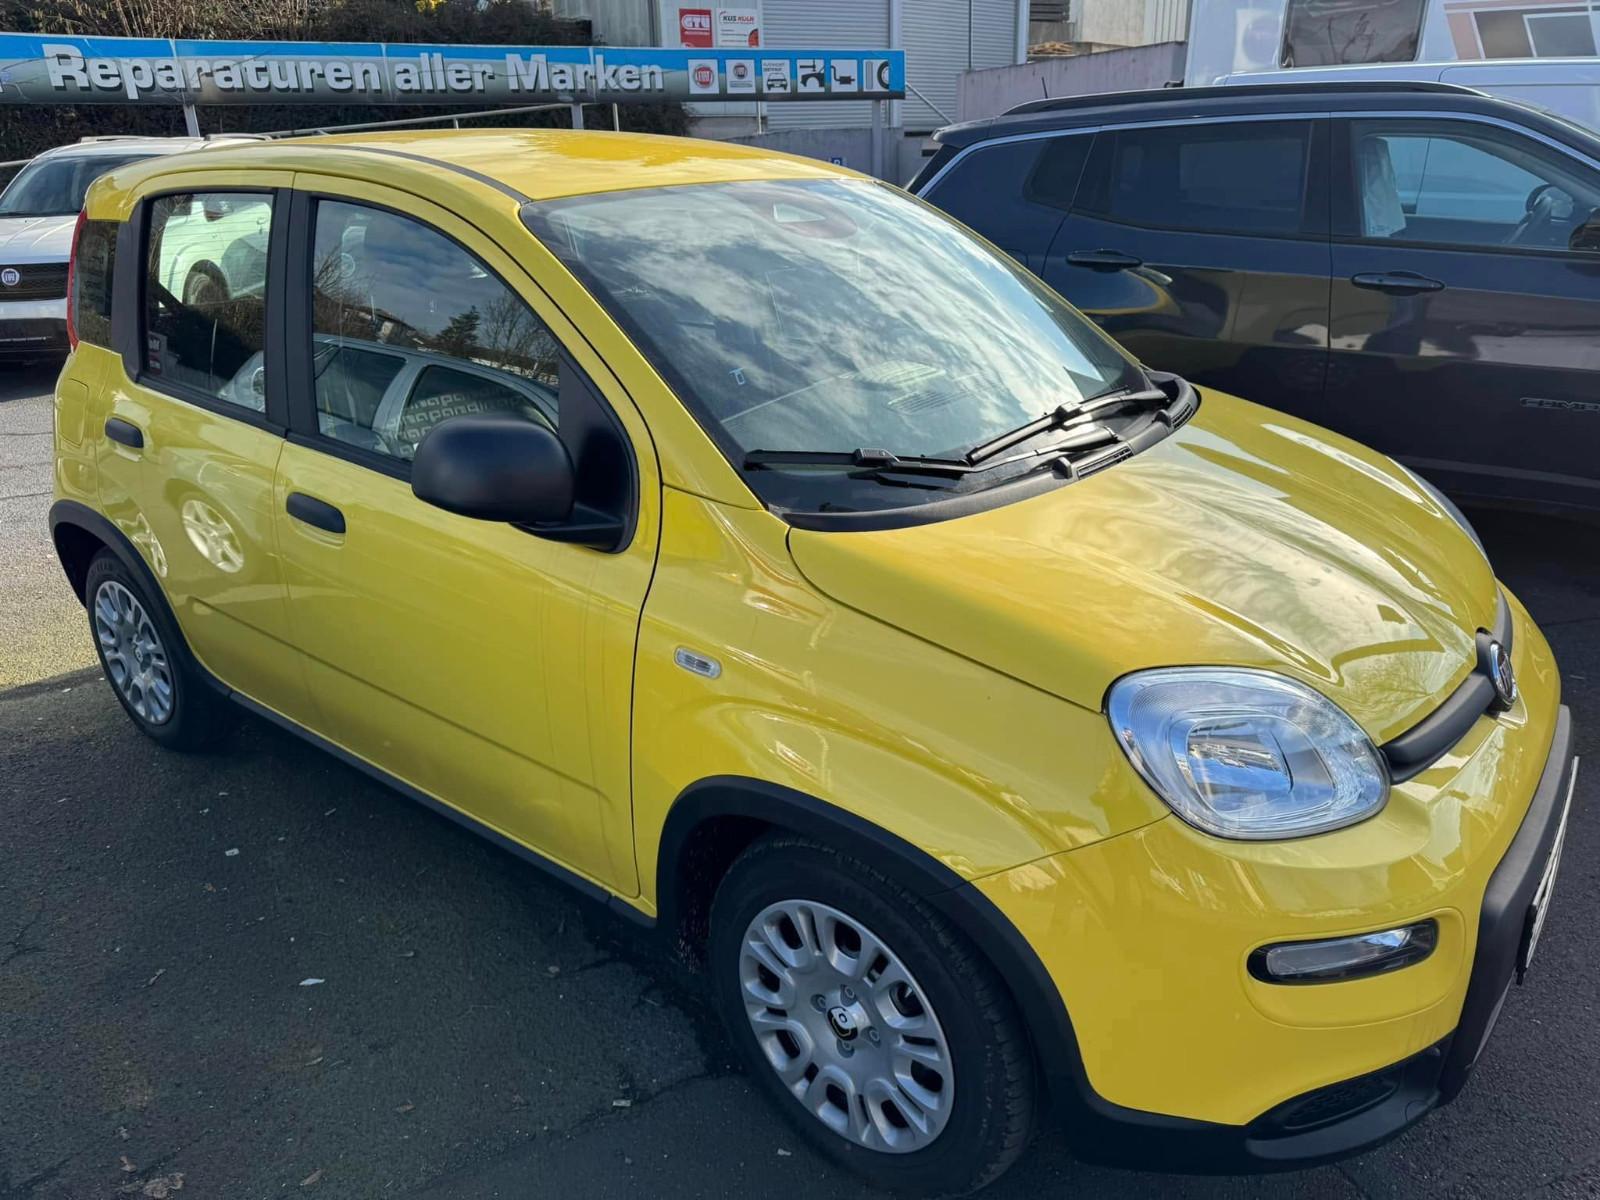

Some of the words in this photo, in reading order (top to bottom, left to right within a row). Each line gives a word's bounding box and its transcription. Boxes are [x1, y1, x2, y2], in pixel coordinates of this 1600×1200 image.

[42, 44, 381, 100] Reparaturen
[395, 53, 494, 91] aller
[505, 53, 665, 91] Marken
